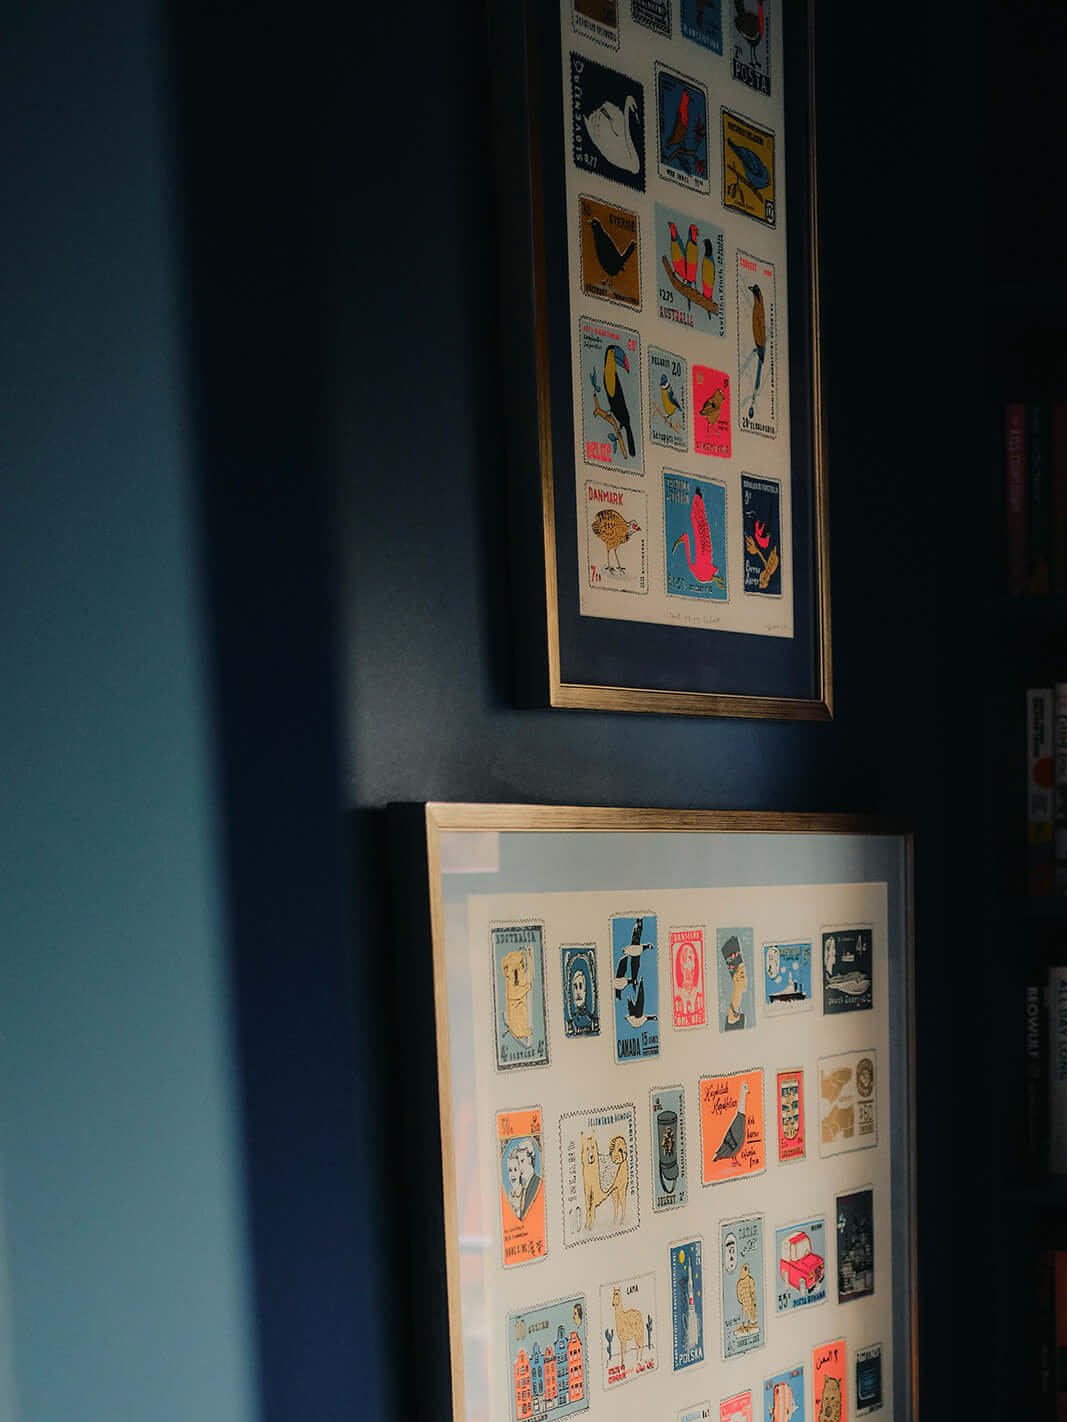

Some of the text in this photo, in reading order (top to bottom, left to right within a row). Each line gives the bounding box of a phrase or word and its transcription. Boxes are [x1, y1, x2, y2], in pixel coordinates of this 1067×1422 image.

[734, 63, 769, 95] POSTA
[659, 305, 695, 328] AUSTRALIA
[588, 486, 624, 506] DANMARK
[496, 931, 536, 945] AUSTRALIA
[1027, 986, 1043, 1058] BEOWULF
[616, 1038, 641, 1058] CANADA
[678, 1347, 704, 1366] POLSKA
